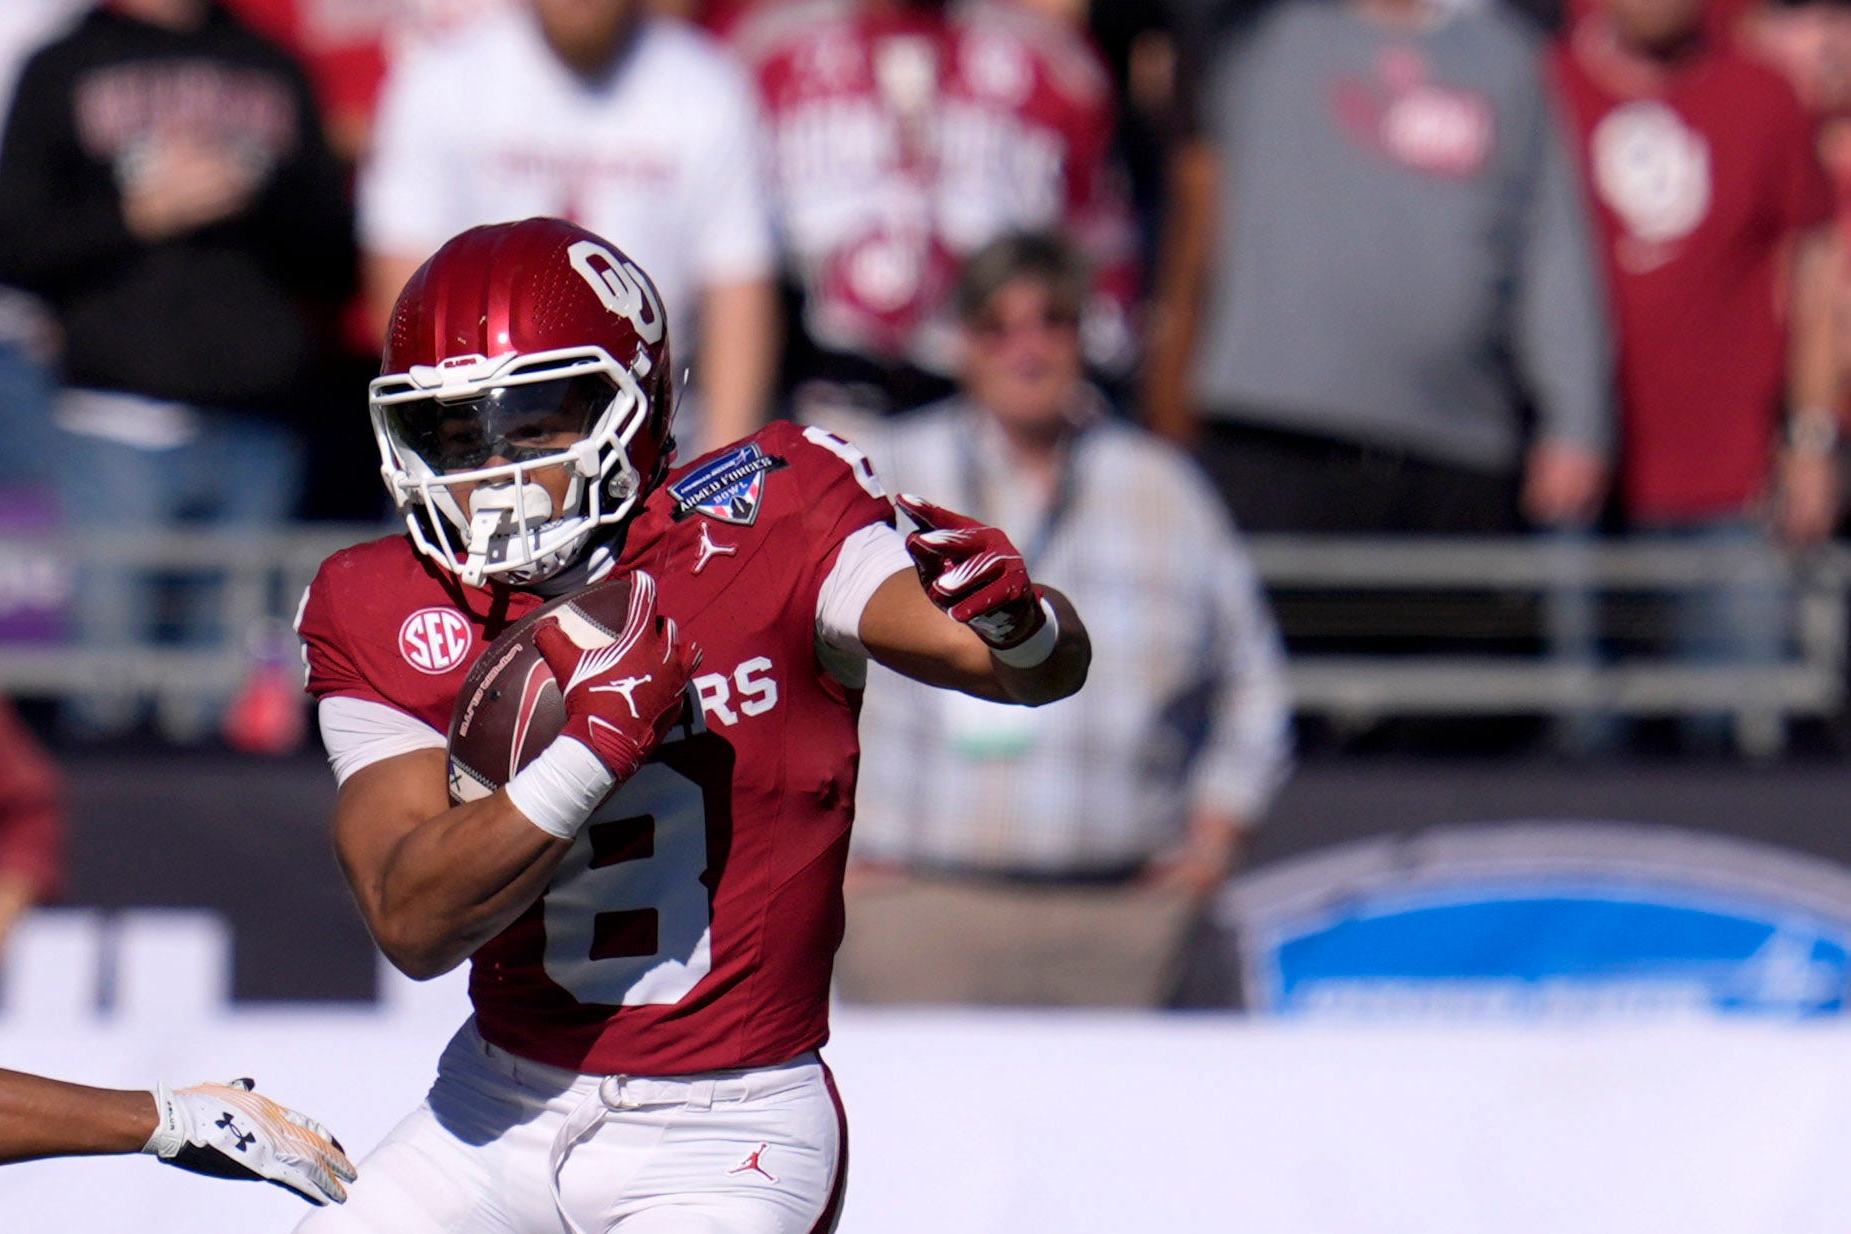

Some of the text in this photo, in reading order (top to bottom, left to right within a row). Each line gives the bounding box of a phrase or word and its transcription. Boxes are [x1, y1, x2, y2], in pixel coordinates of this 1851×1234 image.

[567, 239, 663, 346] OU
[680, 481, 721, 512] ARMED
[712, 481, 748, 505] BOWL
[404, 611, 466, 670] SEC
[543, 761, 713, 1007] 8
